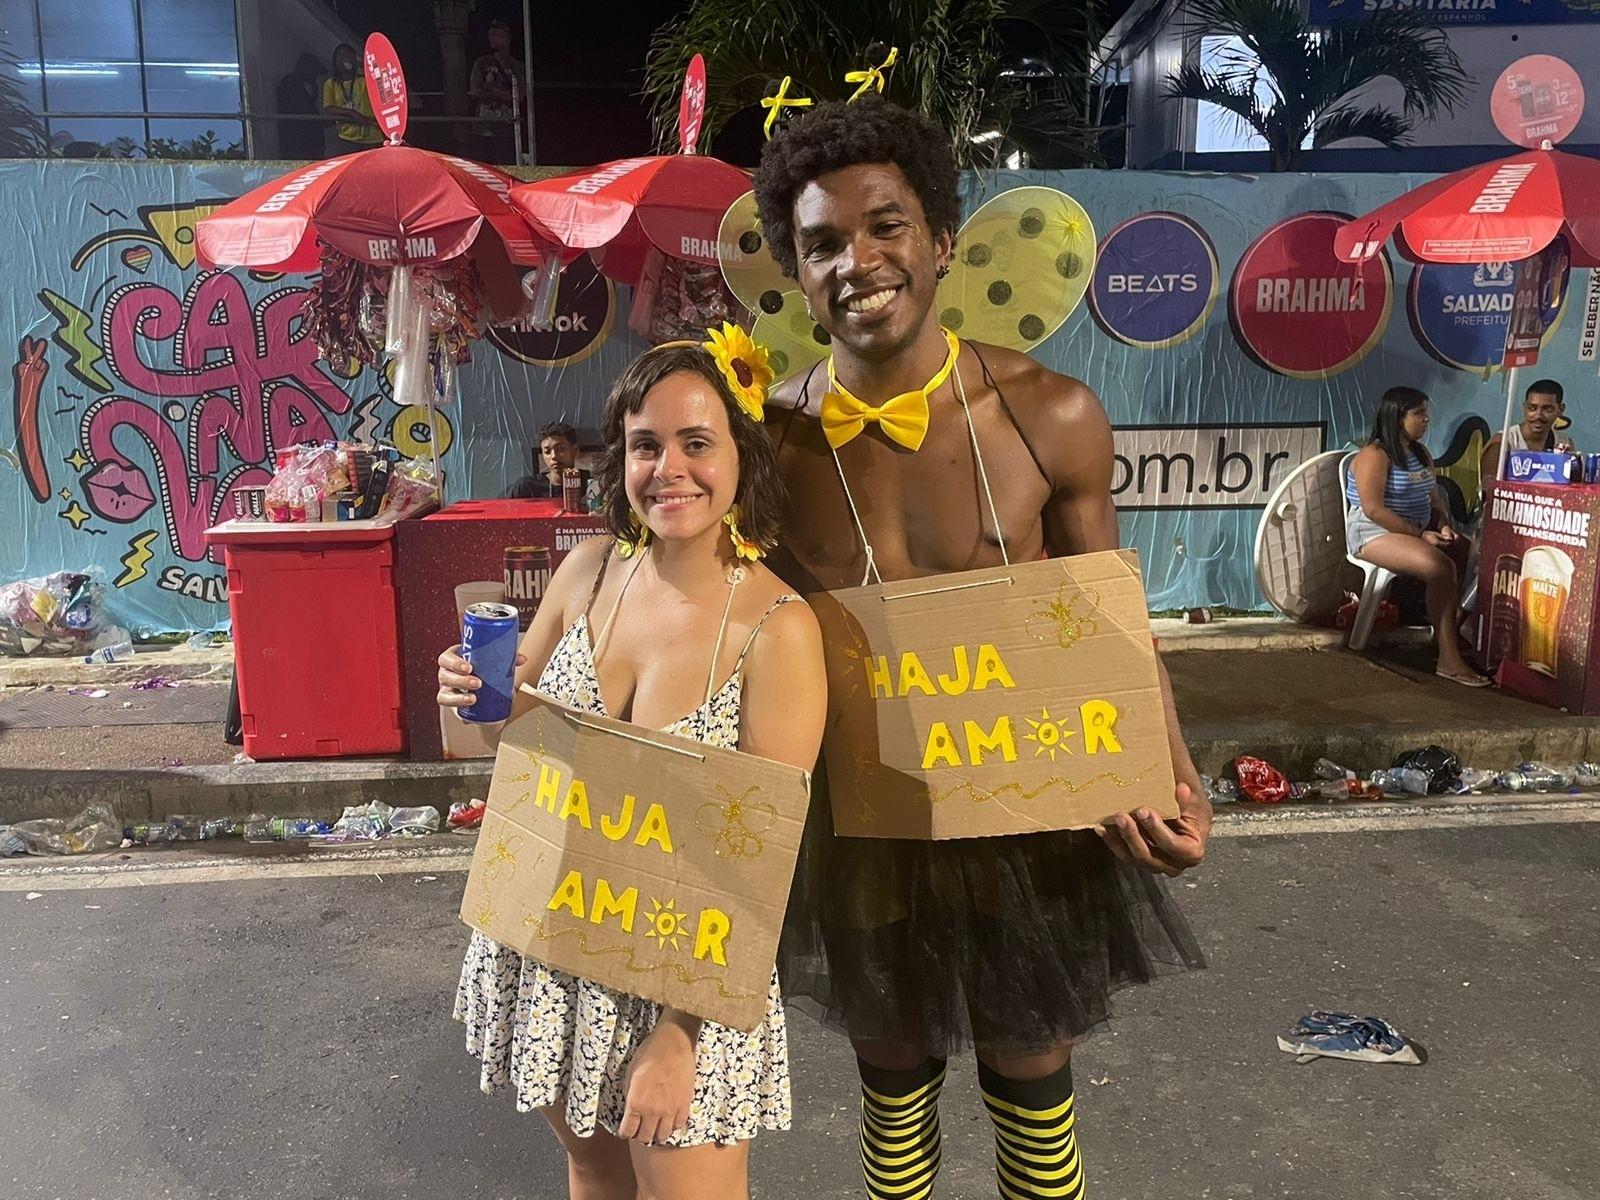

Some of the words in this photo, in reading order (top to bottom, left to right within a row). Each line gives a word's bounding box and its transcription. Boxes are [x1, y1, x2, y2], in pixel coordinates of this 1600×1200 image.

[1506, 75, 1516, 90] 5
[1552, 79, 1561, 90] 3
[1555, 91, 1569, 106] 12
[1526, 123, 1559, 139] BRAHMA
[1468, 163, 1538, 213] BRAHMA
[1108, 274, 1197, 293] BEATS
[1256, 276, 1366, 313] BRAHMA
[1442, 293, 1514, 313] SALVAD
[1454, 314, 1509, 326] PREFEITU
[1586, 297, 1599, 338] BEBER
[1583, 341, 1594, 357] SE
[234, 491, 244, 516] HALLS
[251, 490, 262, 516] HALLS
[1501, 490, 1513, 499] NA
[1515, 491, 1533, 502] RUA
[1534, 495, 1554, 505] QUE
[1554, 499, 1562, 508] A
[1491, 498, 1591, 538] BRAHMOSIDADE
[1512, 524, 1588, 549] TRANSBORDA
[157, 566, 229, 603] SALV
[1533, 581, 1559, 599] MALTE
[865, 643, 1016, 698] HAJA
[534, 763, 674, 854] HAJA
